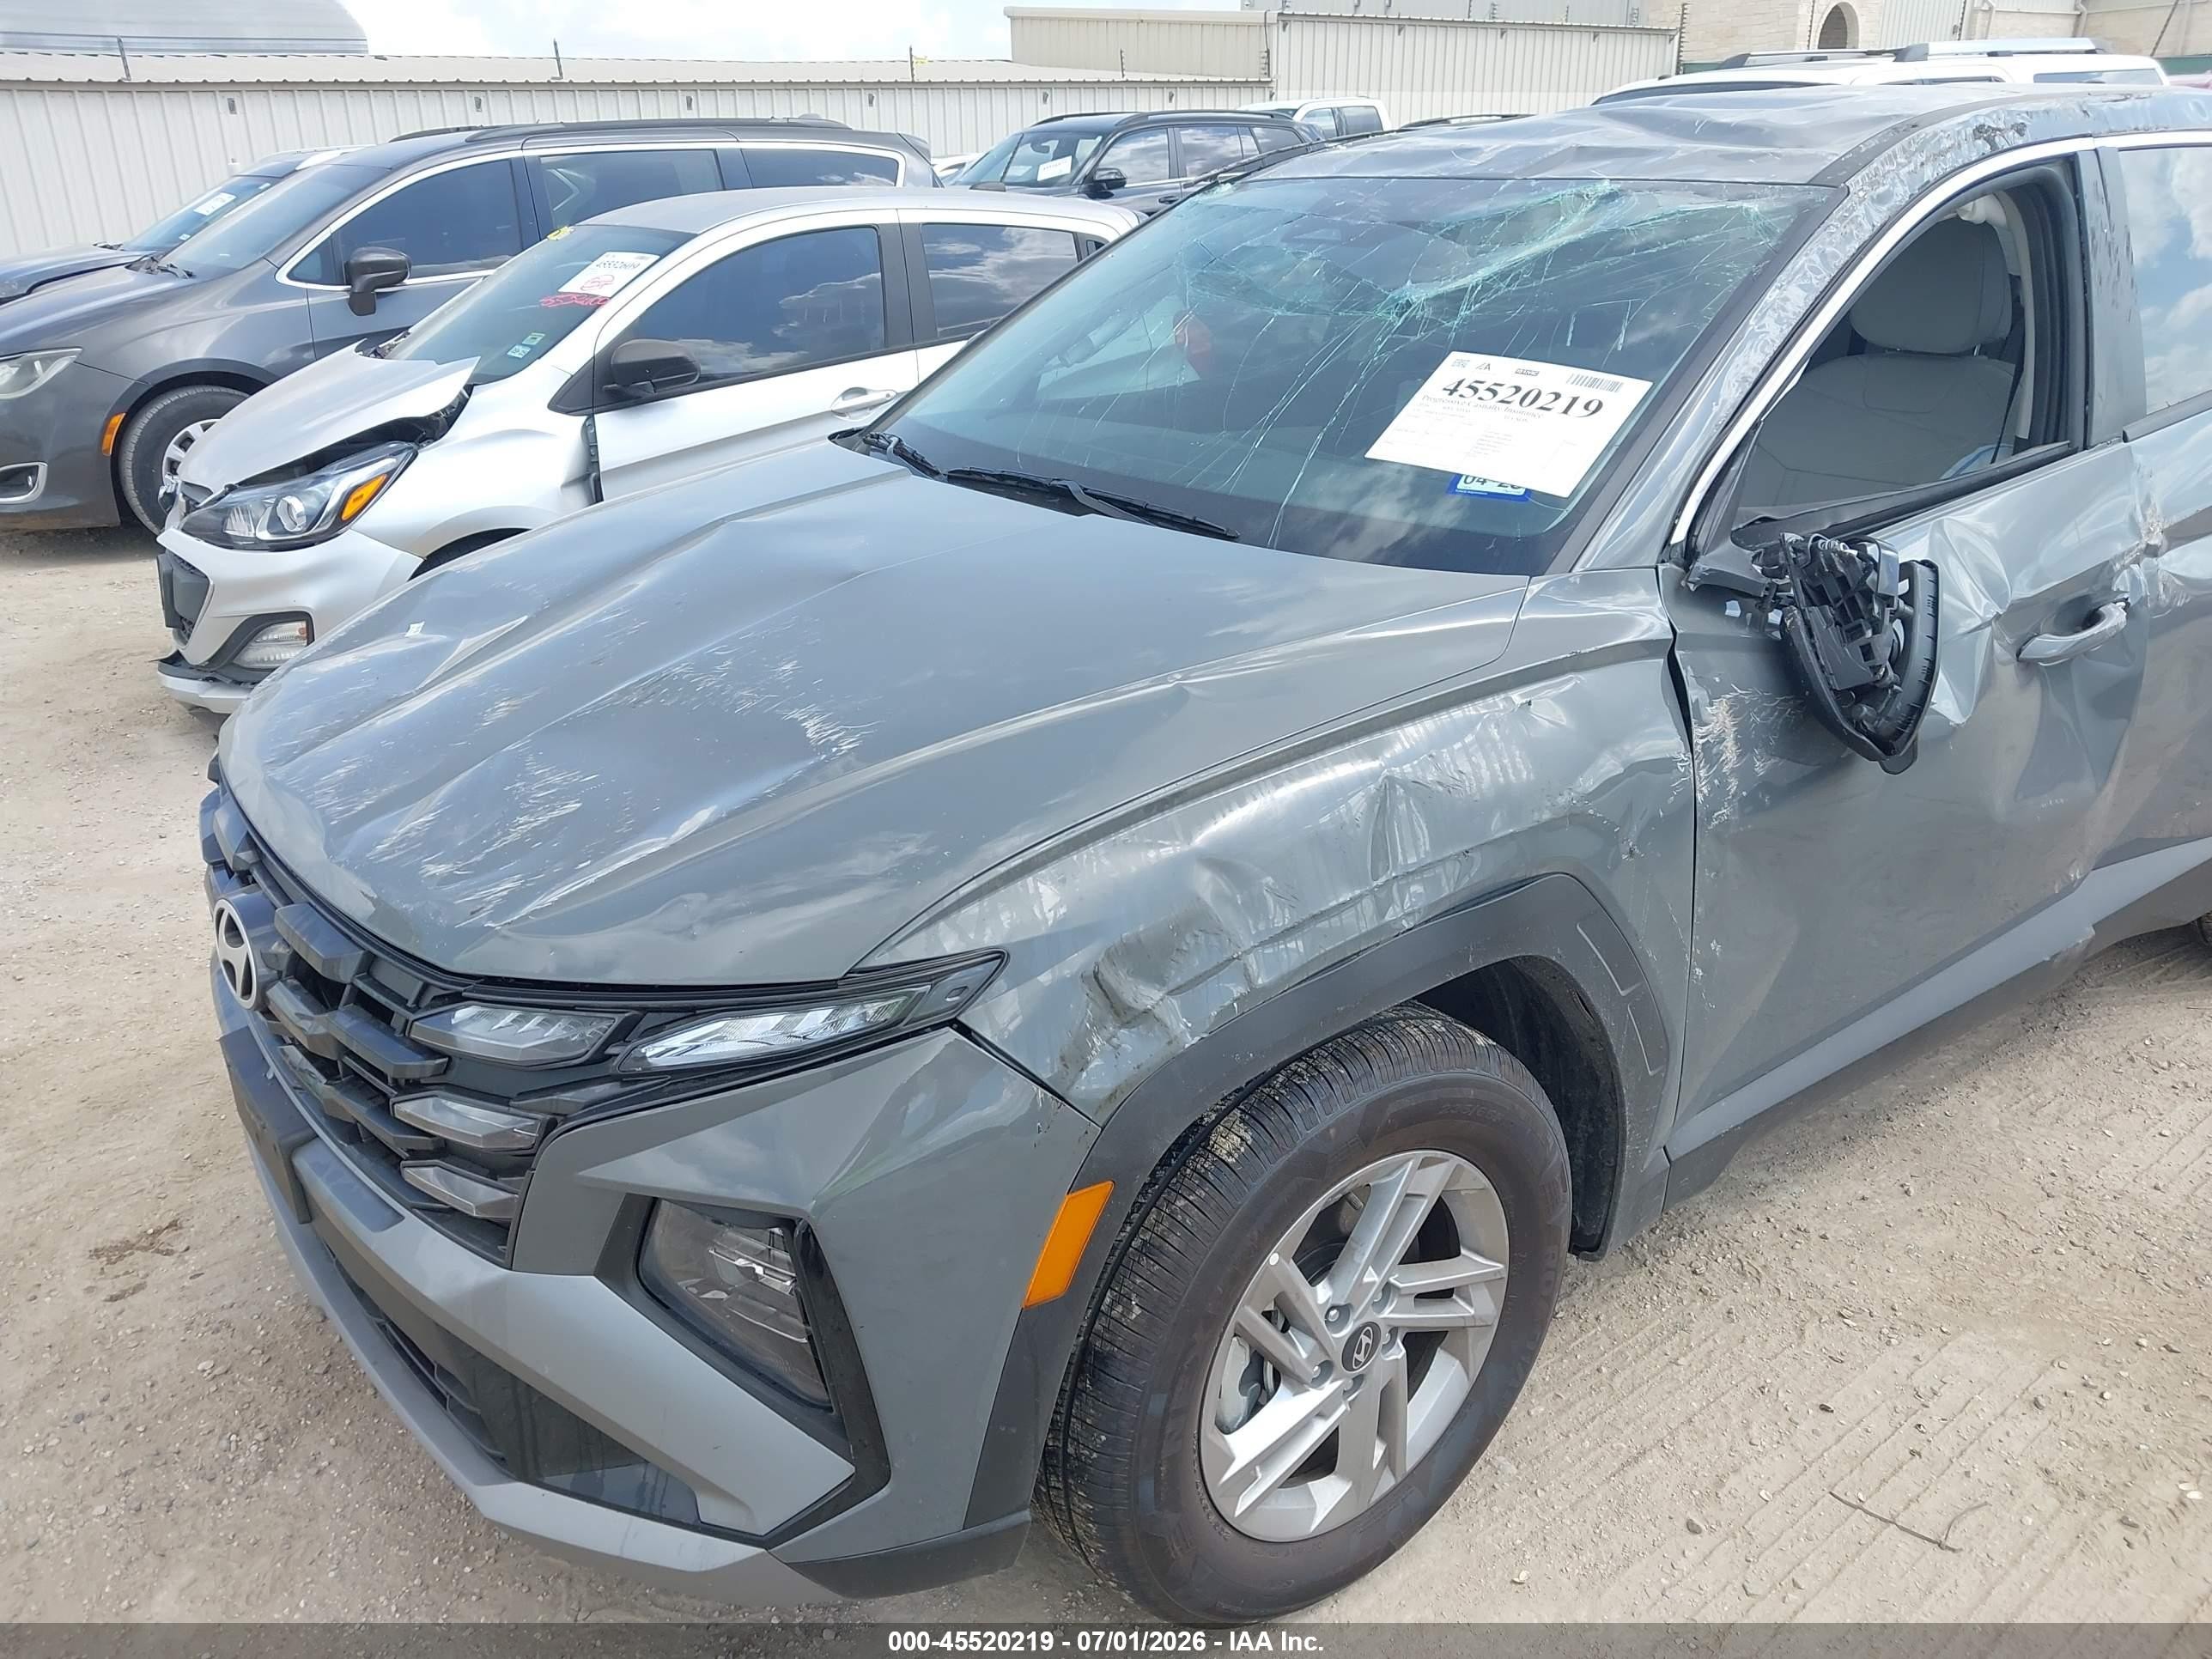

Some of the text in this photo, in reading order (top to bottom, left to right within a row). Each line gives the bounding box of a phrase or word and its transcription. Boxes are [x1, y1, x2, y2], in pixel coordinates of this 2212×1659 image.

[1422, 395, 1466, 408] Progressive
[1504, 407, 1544, 419] Insurance
[1443, 378, 1604, 418] 45520219
